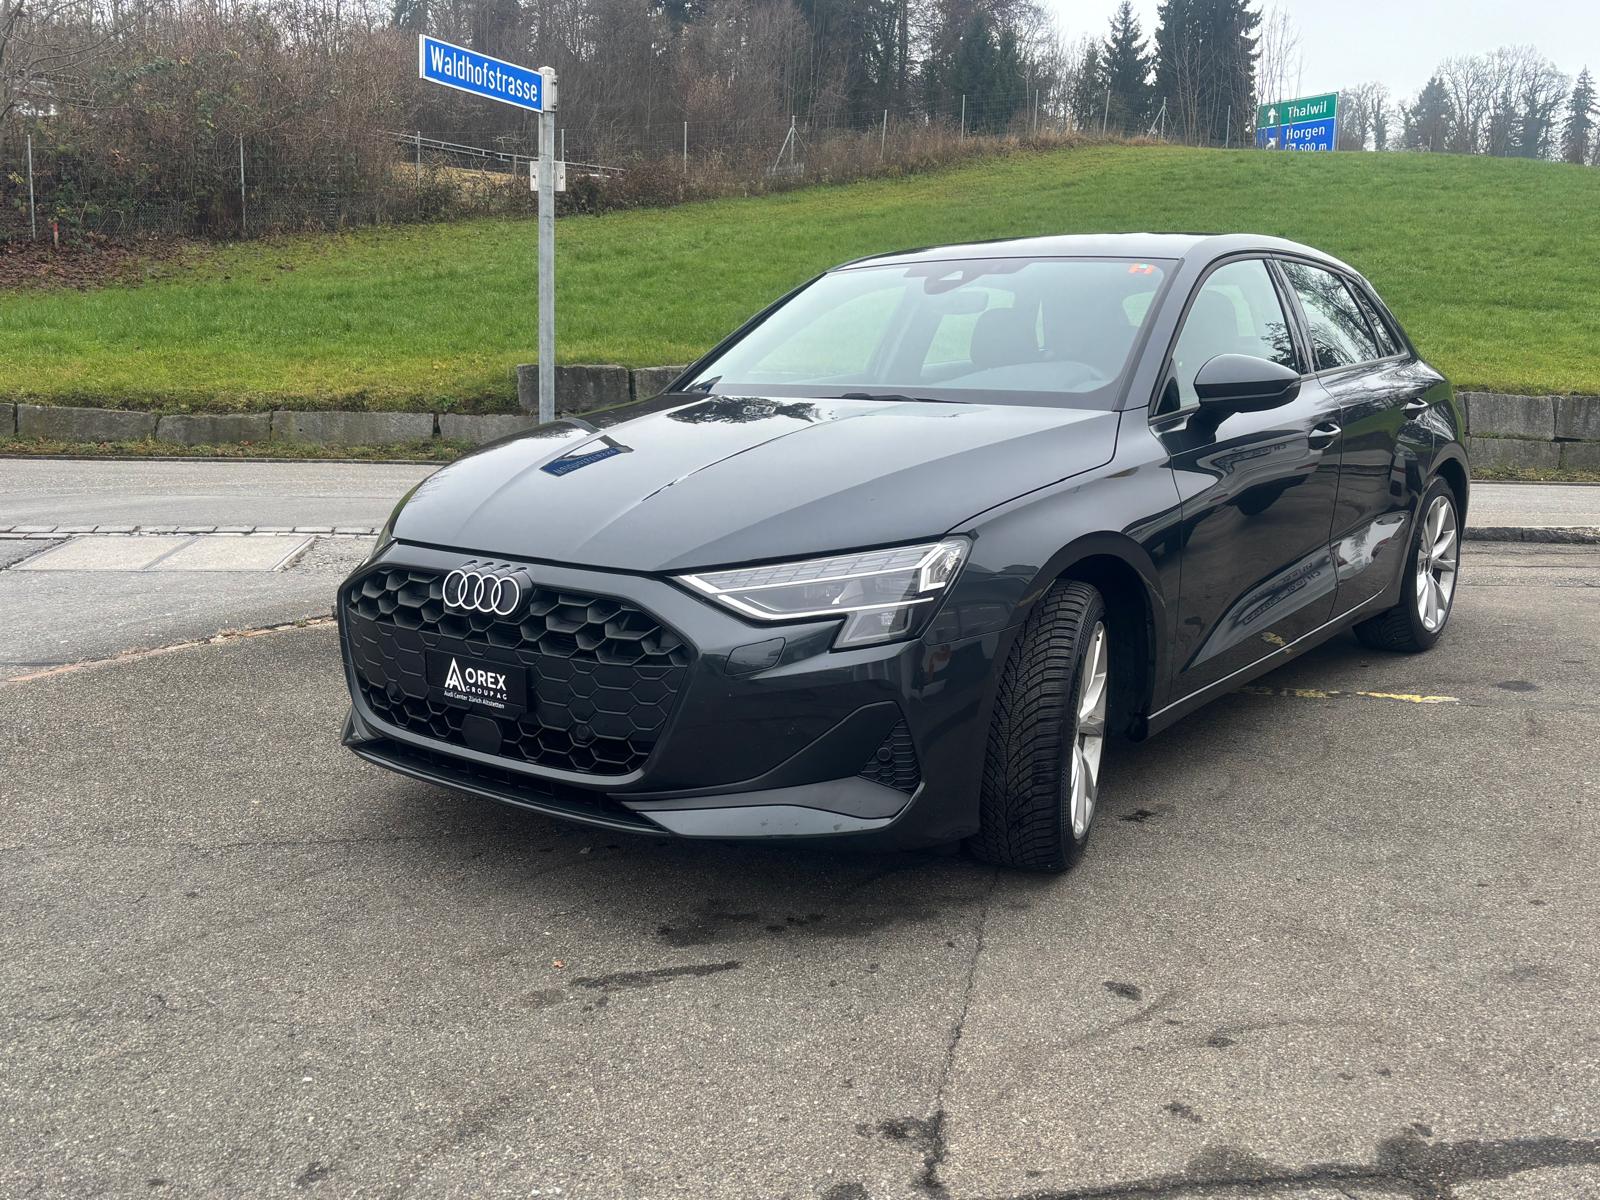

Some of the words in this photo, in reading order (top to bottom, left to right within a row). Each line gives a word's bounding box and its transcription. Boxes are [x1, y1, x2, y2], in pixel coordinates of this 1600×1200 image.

[430, 45, 538, 102] Waldhofstrasse
[1288, 101, 1327, 117] Thalwil
[1286, 126, 1325, 140] Horgen
[444, 690, 454, 698] Audi
[453, 692, 468, 701] Center
[466, 685, 494, 697] GROUP
[497, 692, 507, 700] AG
